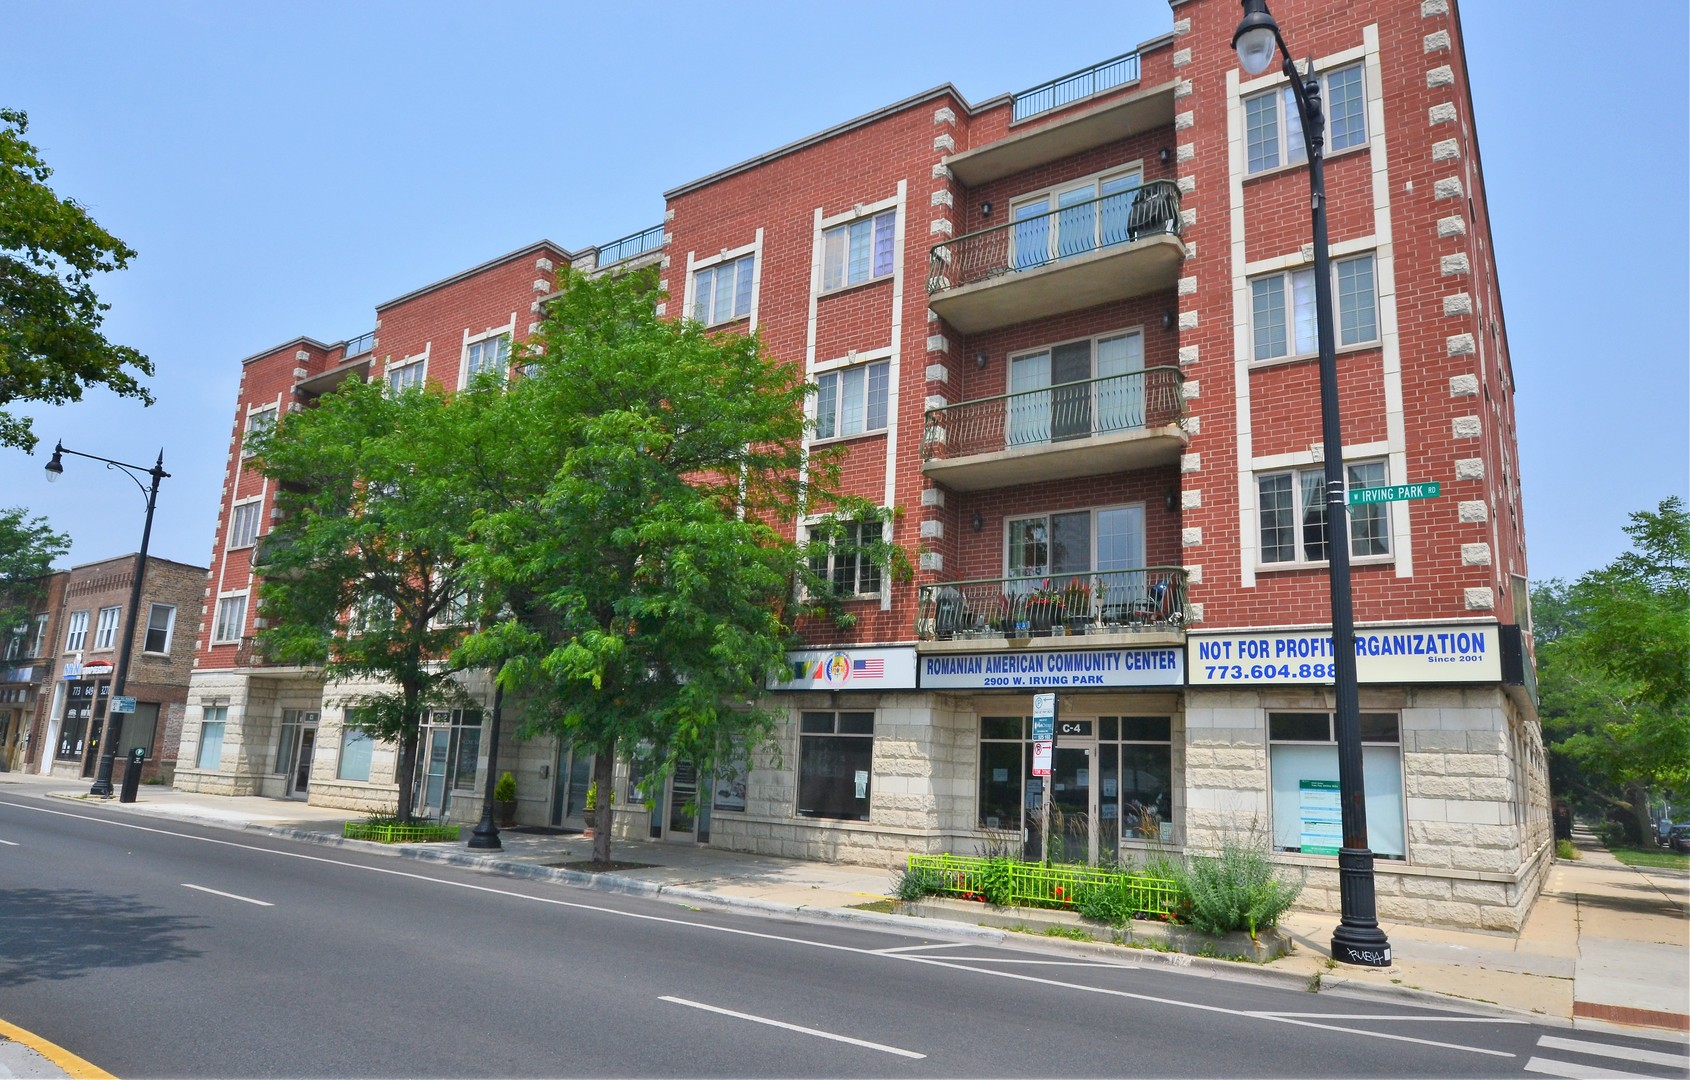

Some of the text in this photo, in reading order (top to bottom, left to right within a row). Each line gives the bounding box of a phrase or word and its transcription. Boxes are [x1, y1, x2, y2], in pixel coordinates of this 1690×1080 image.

[1362, 488, 1393, 502] IRVING
[1398, 485, 1423, 498] PARK
[1428, 486, 1436, 494] RD
[1199, 632, 1485, 660] NOT FOR PROFIT RGANIZATION
[927, 650, 1176, 675] ROMANIAN AMERICAN COMMUNITY CENTER
[1205, 663, 1335, 679] 773.604.888
[984, 675, 1104, 686] 2900 W. IRVING PARK
[72, 686, 81, 696] 773
[1062, 723, 1081, 733] C-4
